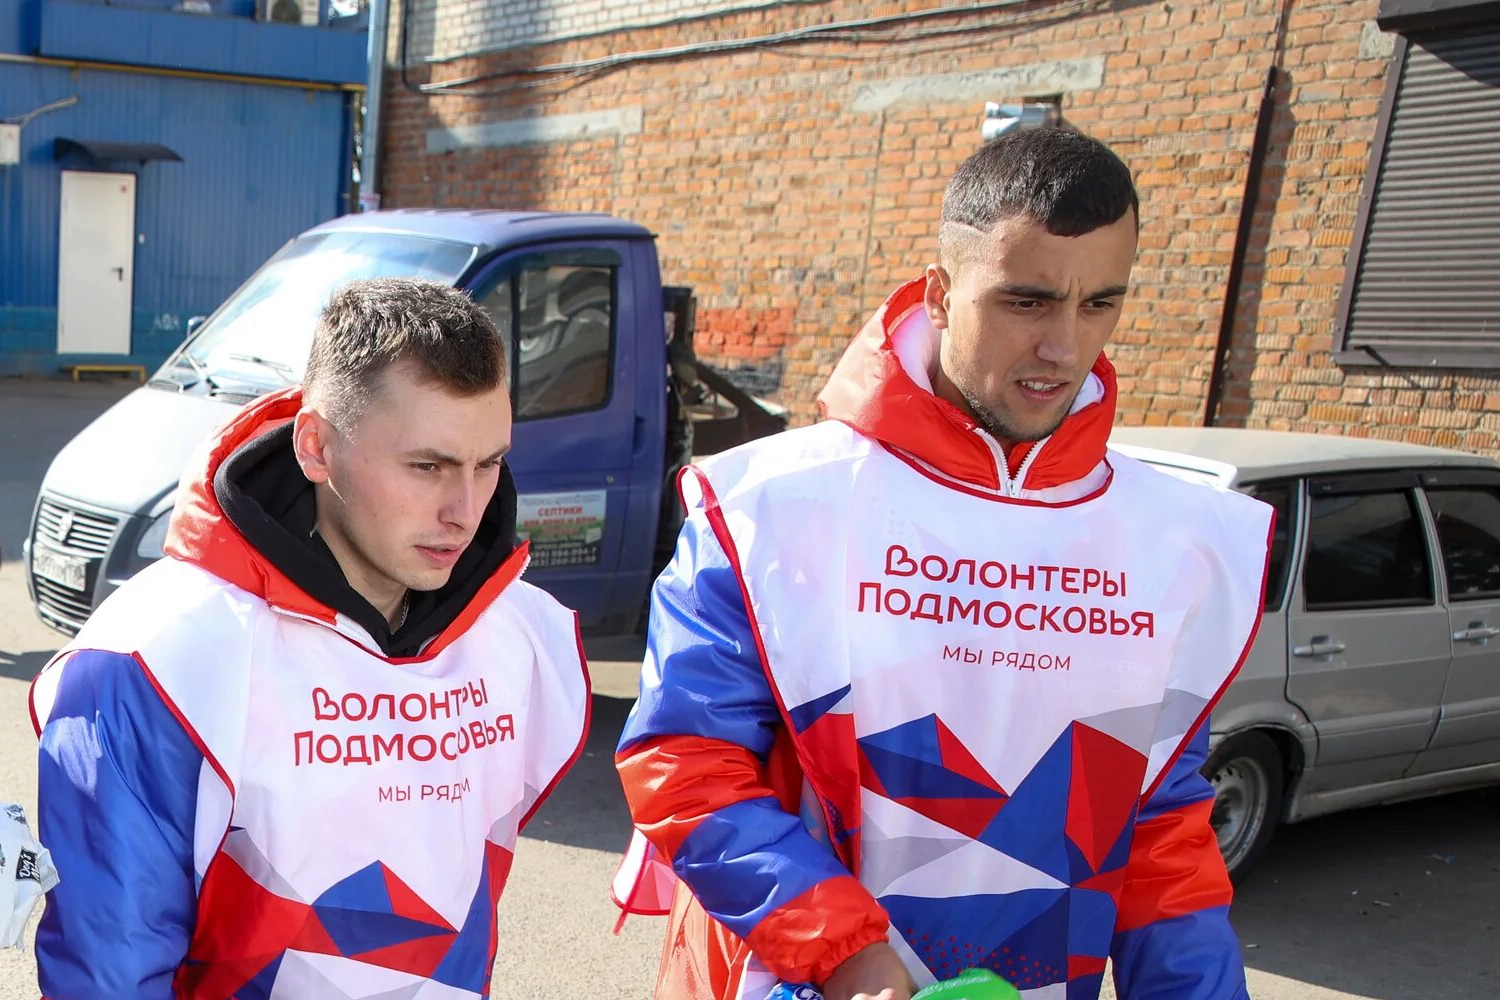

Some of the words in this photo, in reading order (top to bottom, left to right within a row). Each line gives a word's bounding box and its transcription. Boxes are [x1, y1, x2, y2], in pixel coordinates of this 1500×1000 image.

[883, 544, 1127, 597] ВОЛОНТЕРЫ
[857, 582, 1155, 638] ПОДМОСКОВЬЯ
[942, 644, 983, 665] МЫ
[991, 650, 1072, 672] РЯДОМ
[294, 714, 515, 767] ПОДМОСОВЬЯ
[378, 785, 411, 803] МЫ
